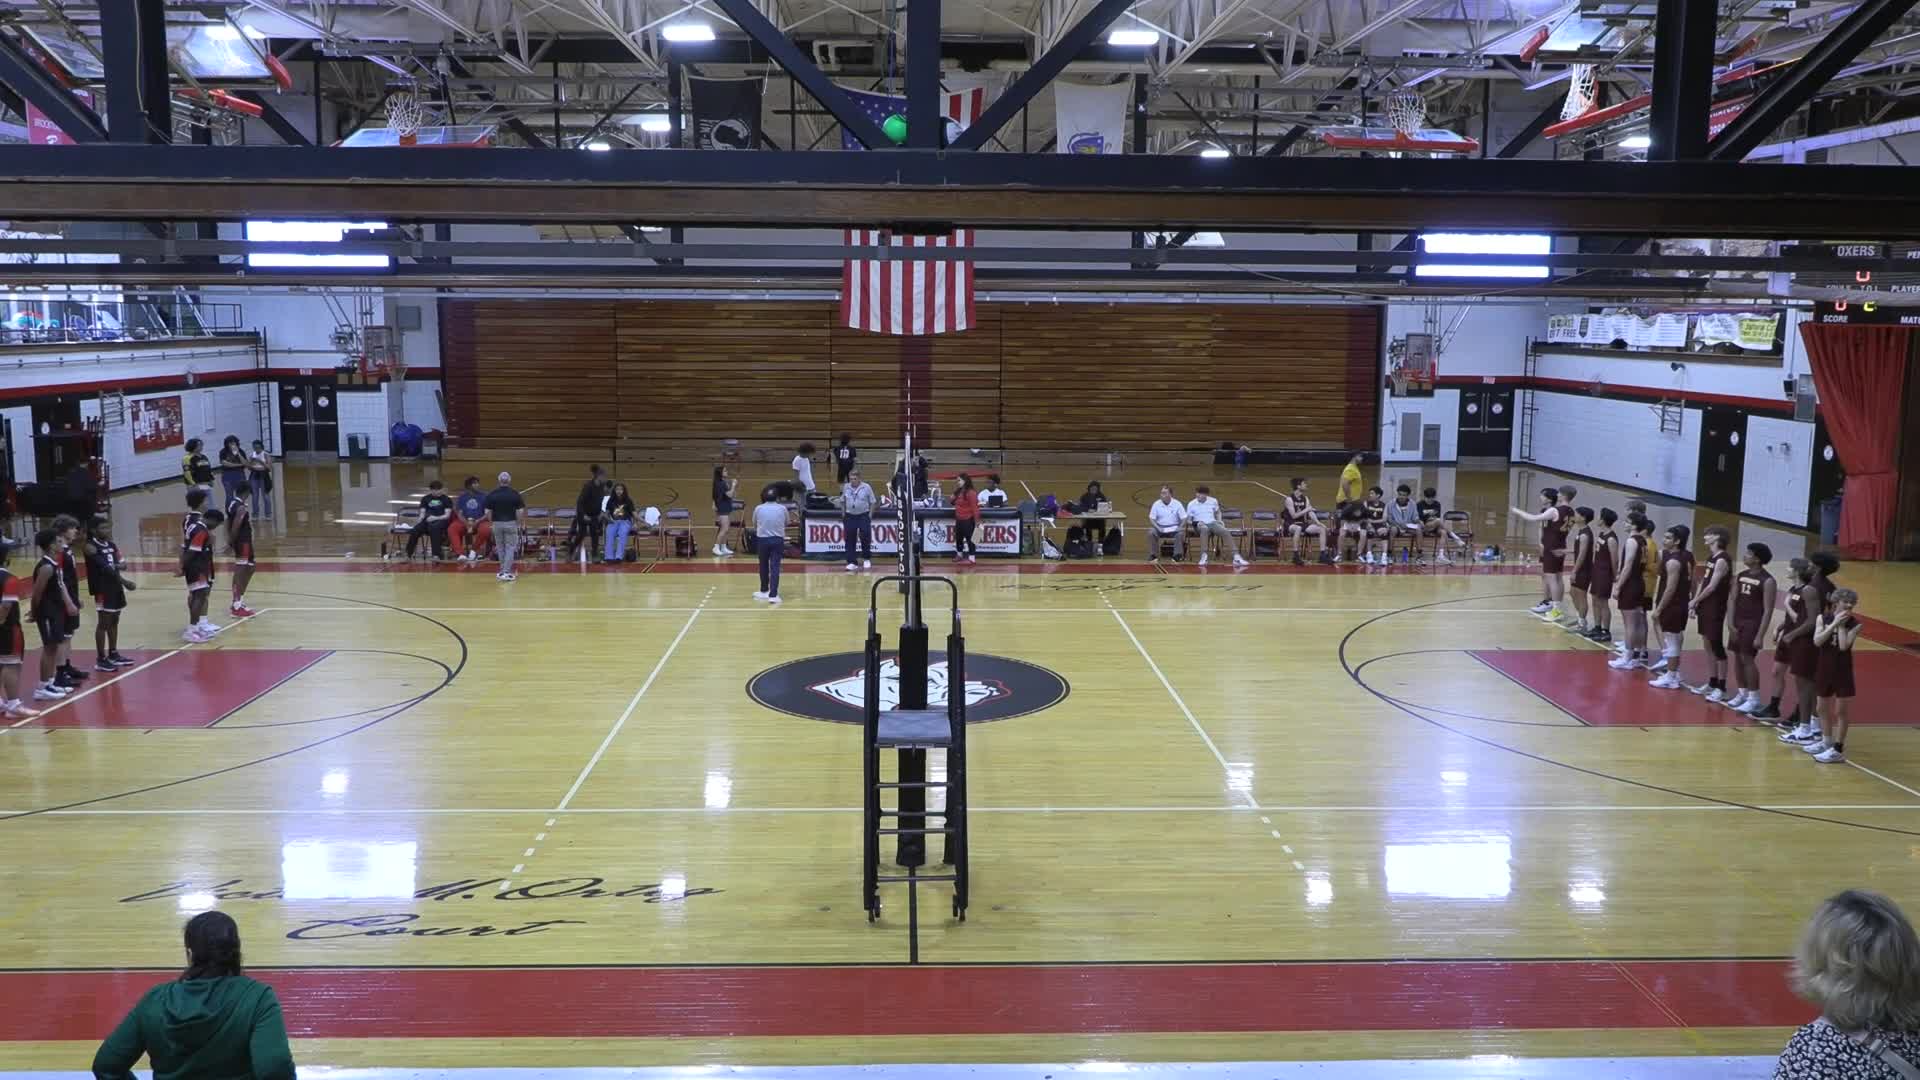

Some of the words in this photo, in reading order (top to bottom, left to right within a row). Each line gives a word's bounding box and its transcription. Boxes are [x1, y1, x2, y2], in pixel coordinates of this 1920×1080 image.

[1833, 245, 1875, 257] OXERS
[1823, 314, 1848, 323] SCORE
[808, 524, 898, 544] BROTON
[897, 499, 905, 584] BROCKTO
[946, 525, 1017, 544] BERS
